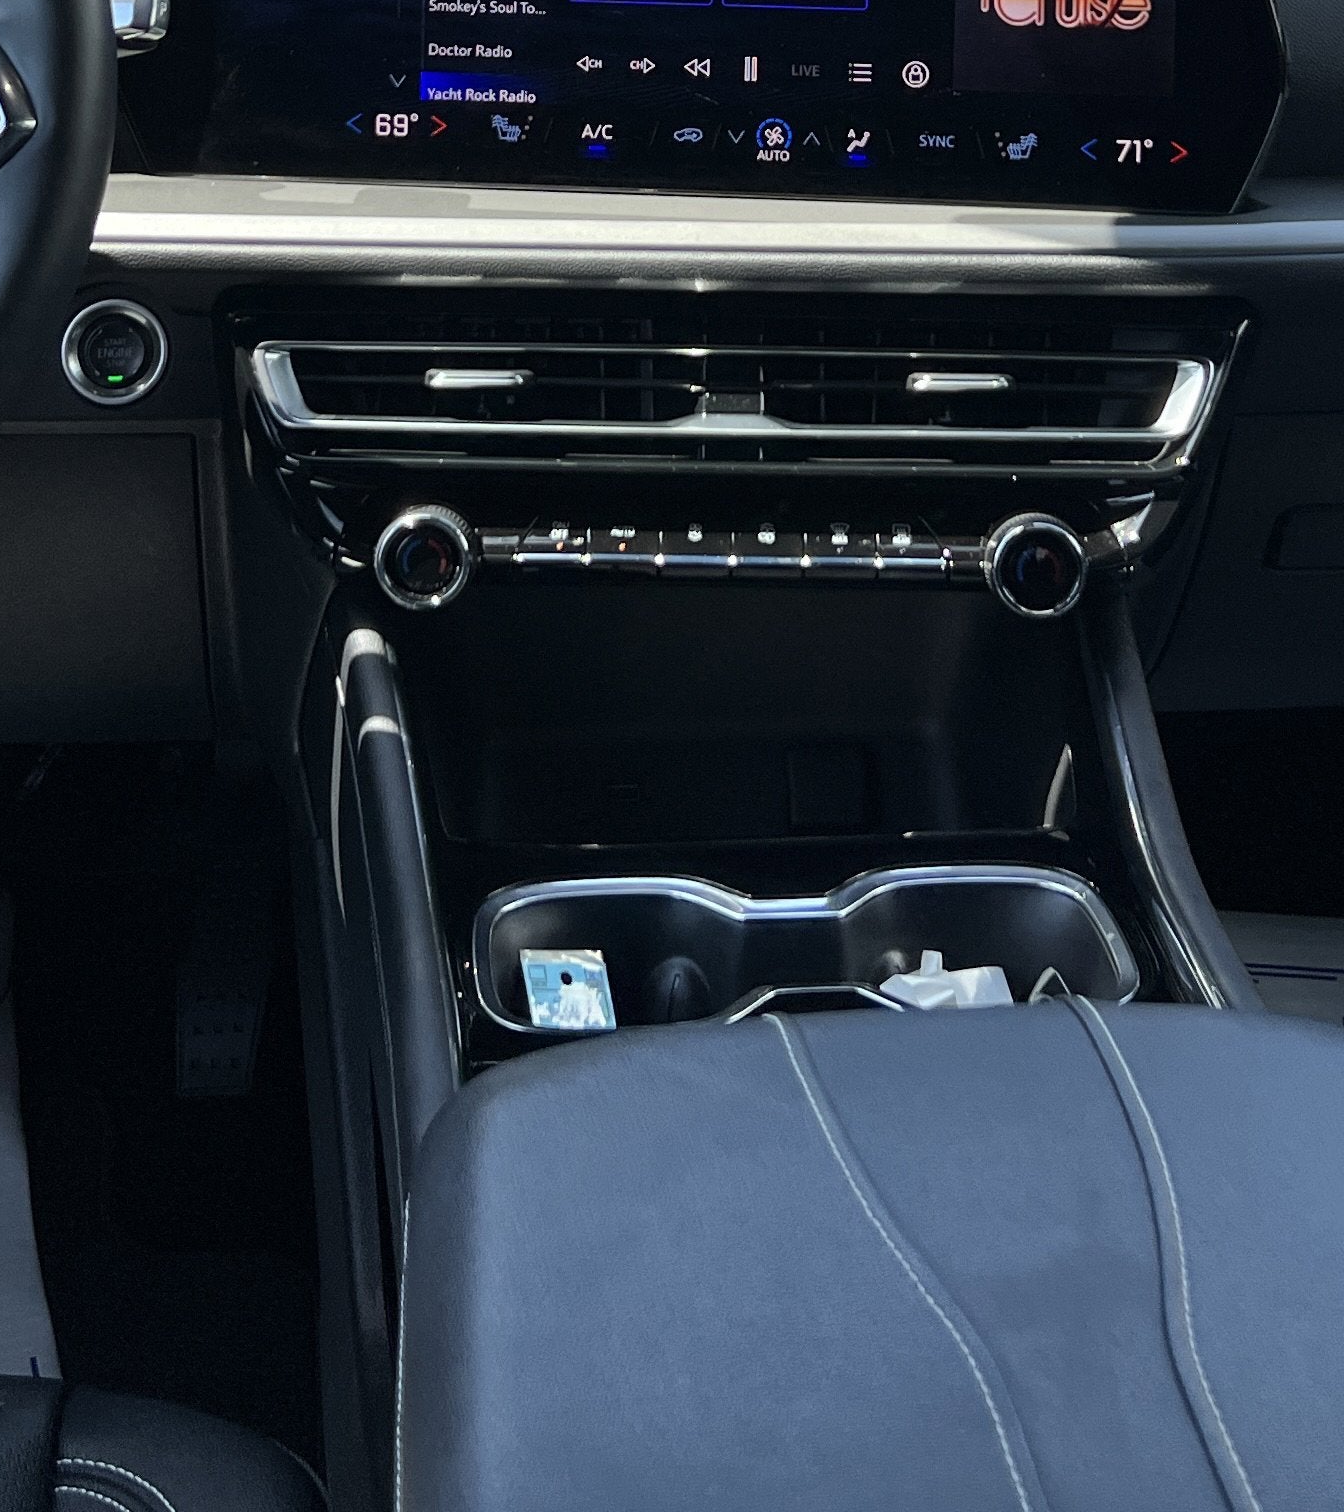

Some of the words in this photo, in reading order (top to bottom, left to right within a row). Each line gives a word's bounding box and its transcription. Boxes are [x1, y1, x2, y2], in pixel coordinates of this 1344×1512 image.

[428, 0, 487, 16] Smokey's
[489, 0, 518, 15] Soul
[428, 43, 473, 58] Doctor
[475, 44, 513, 59] Radio
[589, 59, 603, 69] CH
[629, 59, 643, 69] CH
[791, 64, 821, 76] LIVE
[427, 87, 462, 102] Yacht
[465, 88, 496, 103] Rock
[499, 89, 537, 104] Radio
[375, 113, 419, 137] 69°
[581, 124, 613, 139] A/C
[918, 134, 956, 148] SYNC
[757, 149, 790, 162] AUTO
[1115, 139, 1154, 163] 71°
